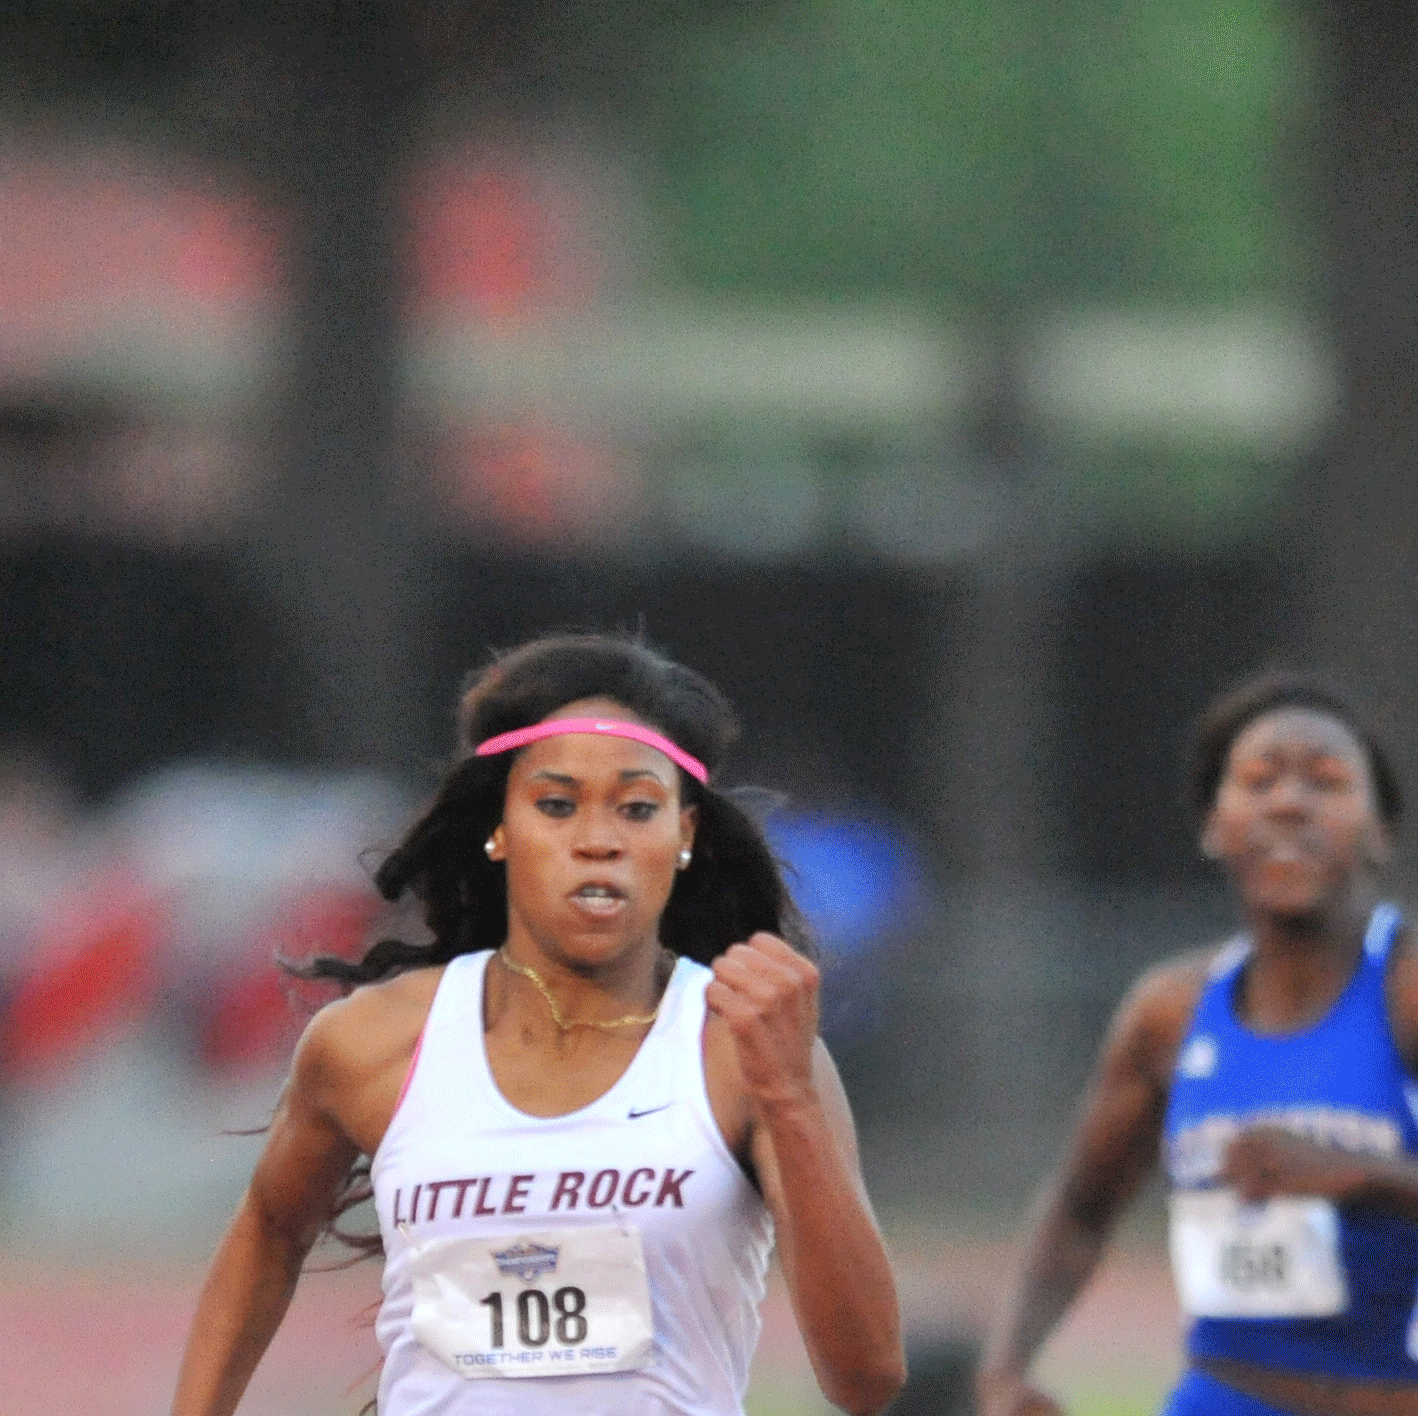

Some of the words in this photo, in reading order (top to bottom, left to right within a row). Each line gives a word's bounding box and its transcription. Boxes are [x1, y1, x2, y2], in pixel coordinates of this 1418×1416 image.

[393, 1173, 535, 1228] LITTLE
[549, 1166, 696, 1211] ROCK
[480, 1286, 589, 1350] 108
[454, 1350, 545, 1367] TOGETHER
[548, 1348, 576, 1362] WE
[580, 1346, 618, 1360] RISE
